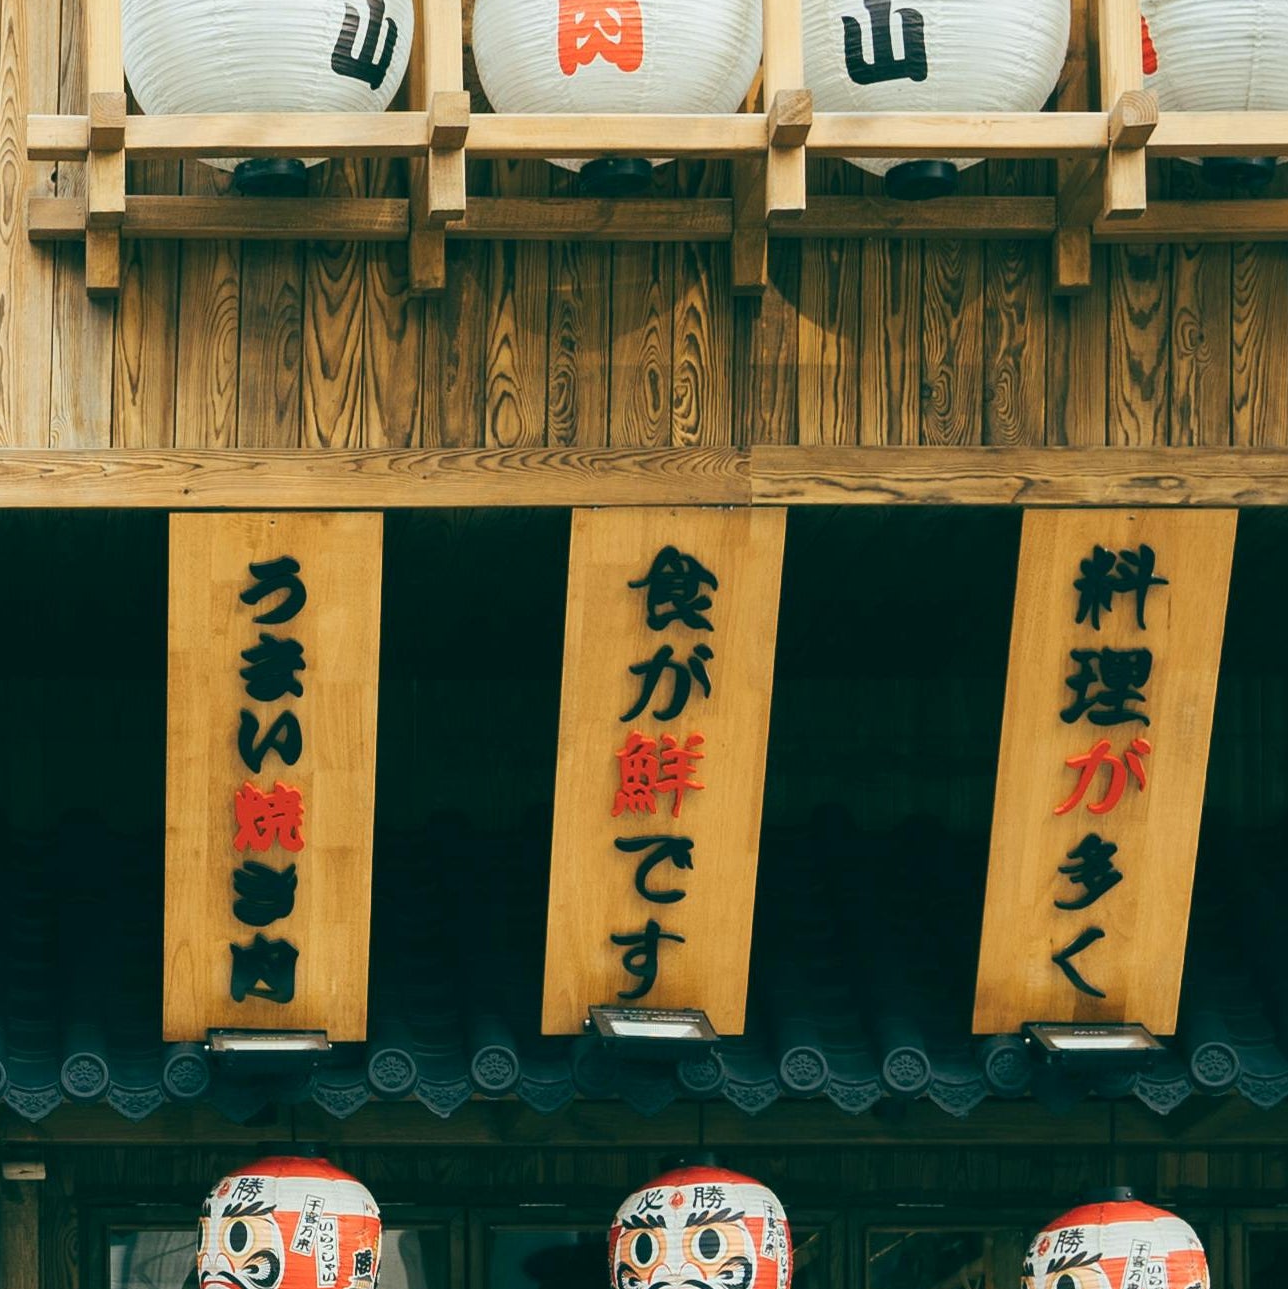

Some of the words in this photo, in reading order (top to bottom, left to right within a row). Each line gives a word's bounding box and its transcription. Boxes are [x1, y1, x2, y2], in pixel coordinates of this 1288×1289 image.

[609, 544, 721, 1001] 食が鮮です
[1051, 544, 1169, 1001] 料理が多く
[231, 1177, 266, 1202] 勝
[636, 1189, 665, 1215] 必
[692, 1185, 726, 1209] 勝
[319, 1219, 337, 1282] いらっしゃい
[1052, 1228, 1086, 1254] 勝
